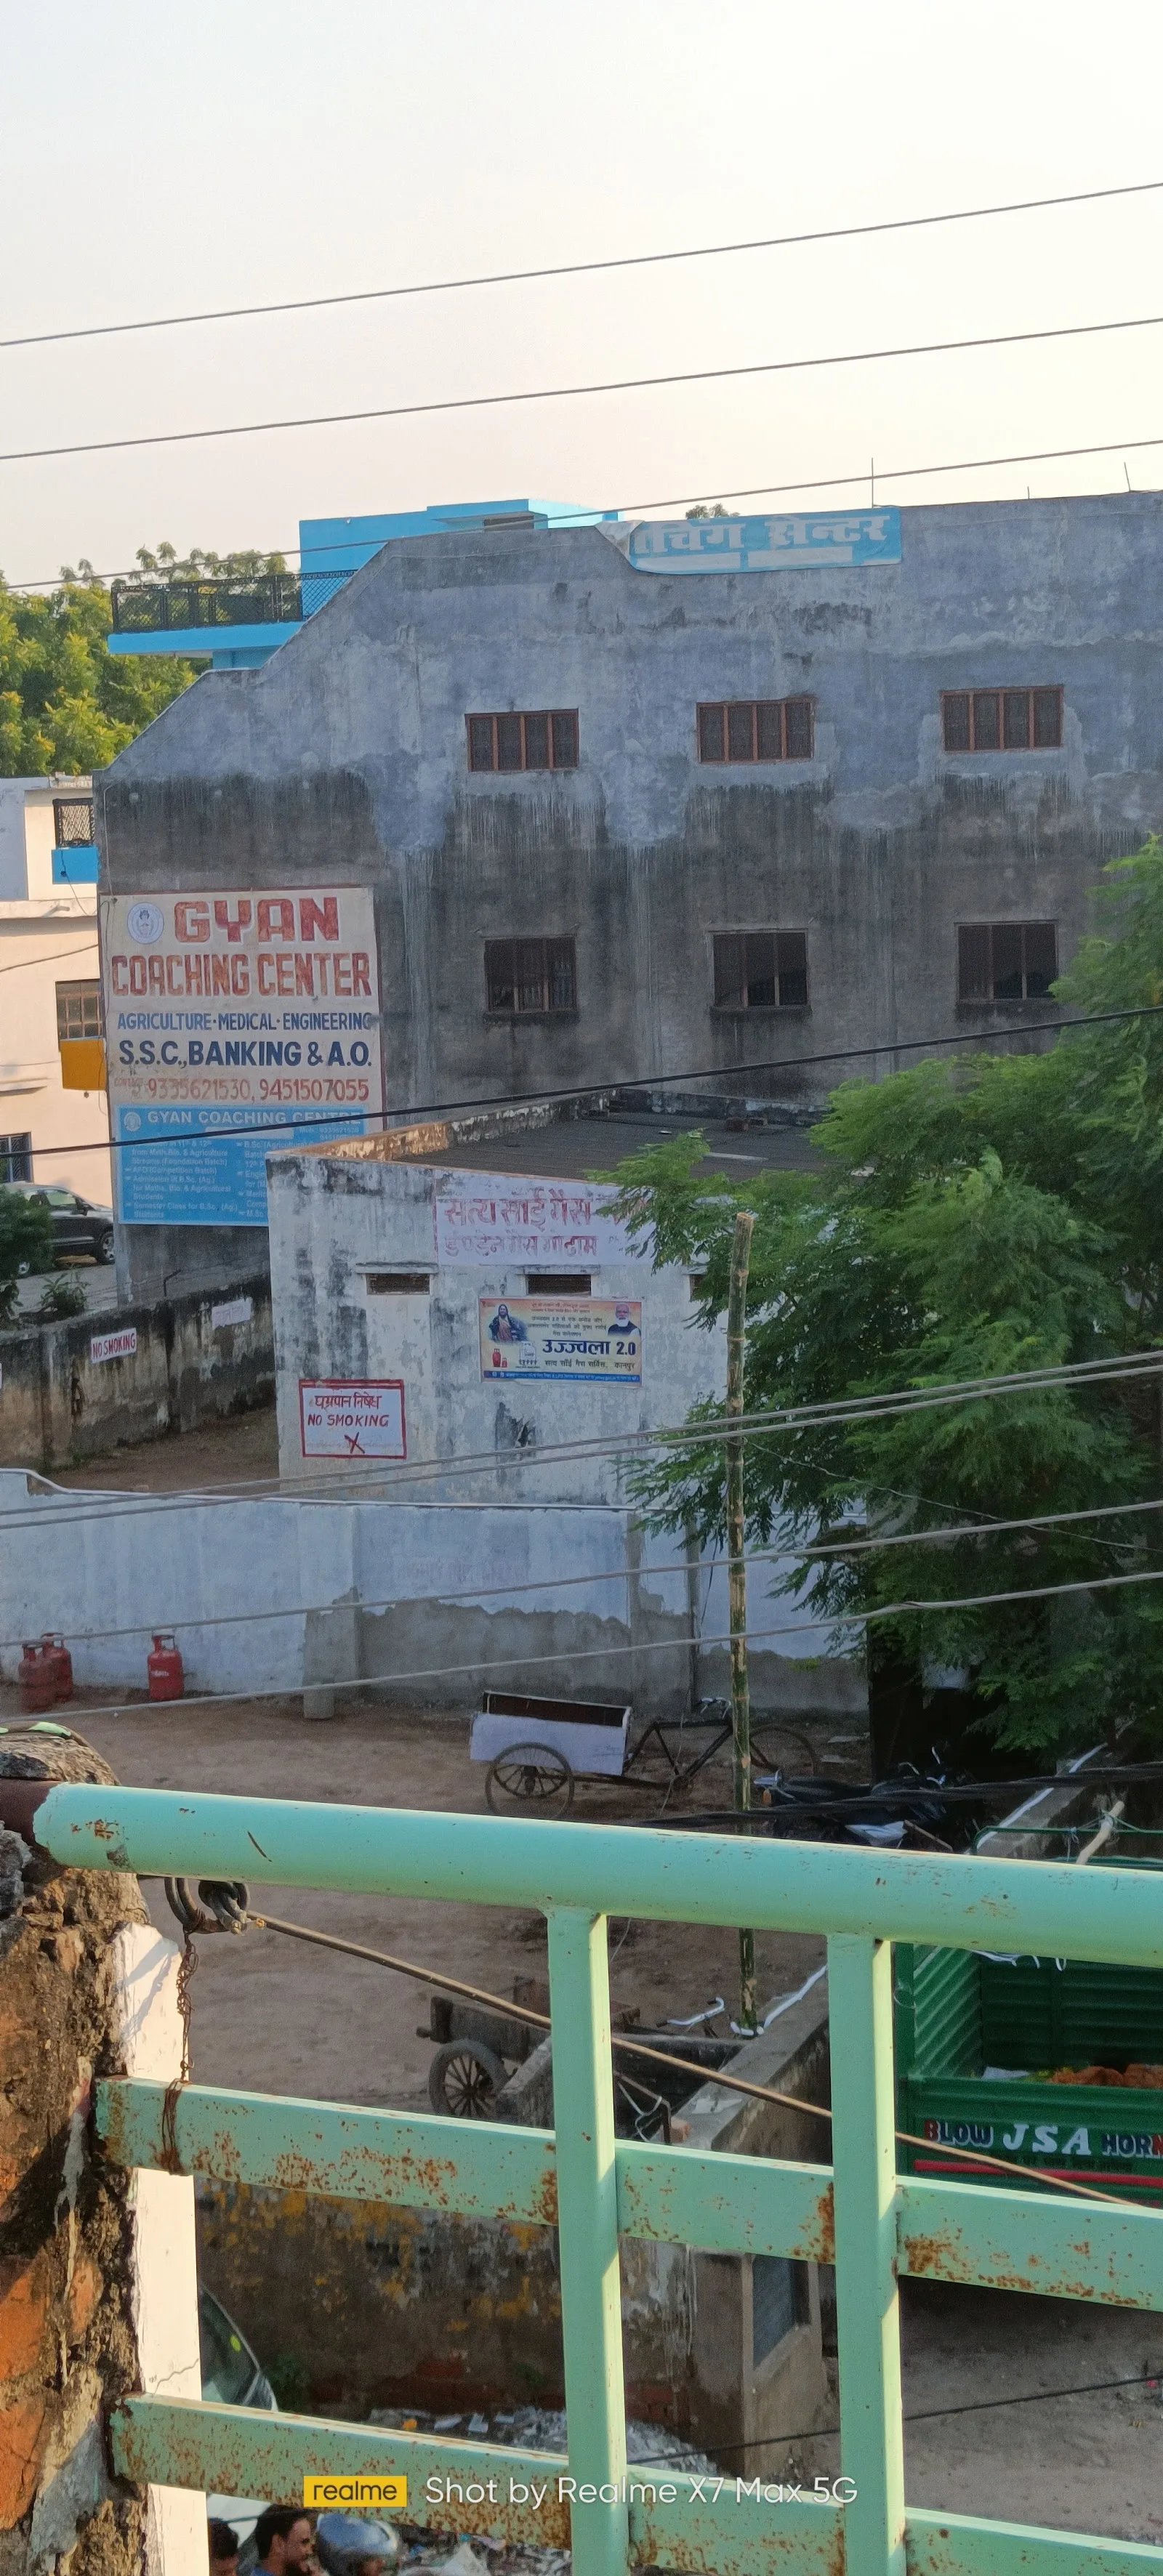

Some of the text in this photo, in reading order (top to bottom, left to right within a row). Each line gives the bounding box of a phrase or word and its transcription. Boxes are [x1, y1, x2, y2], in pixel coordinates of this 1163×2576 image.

[174, 897, 339, 943] GYAN
[111, 952, 372, 997] COACHING CENTER
[307, 1041, 323, 1066] &
[328, 1041, 372, 1067] A.O.
[259, 1078, 369, 1101] 9451507055
[148, 1110, 193, 1123] GYAN
[198, 1110, 286, 1125] COACHING
[93, 1333, 135, 1357] NO SMOKING
[616, 1341, 636, 1356] 2.0
[613, 1361, 635, 1372] कानपुर
[307, 1413, 390, 1427] NO SMOKING
[924, 2119, 994, 2148] BLOW
